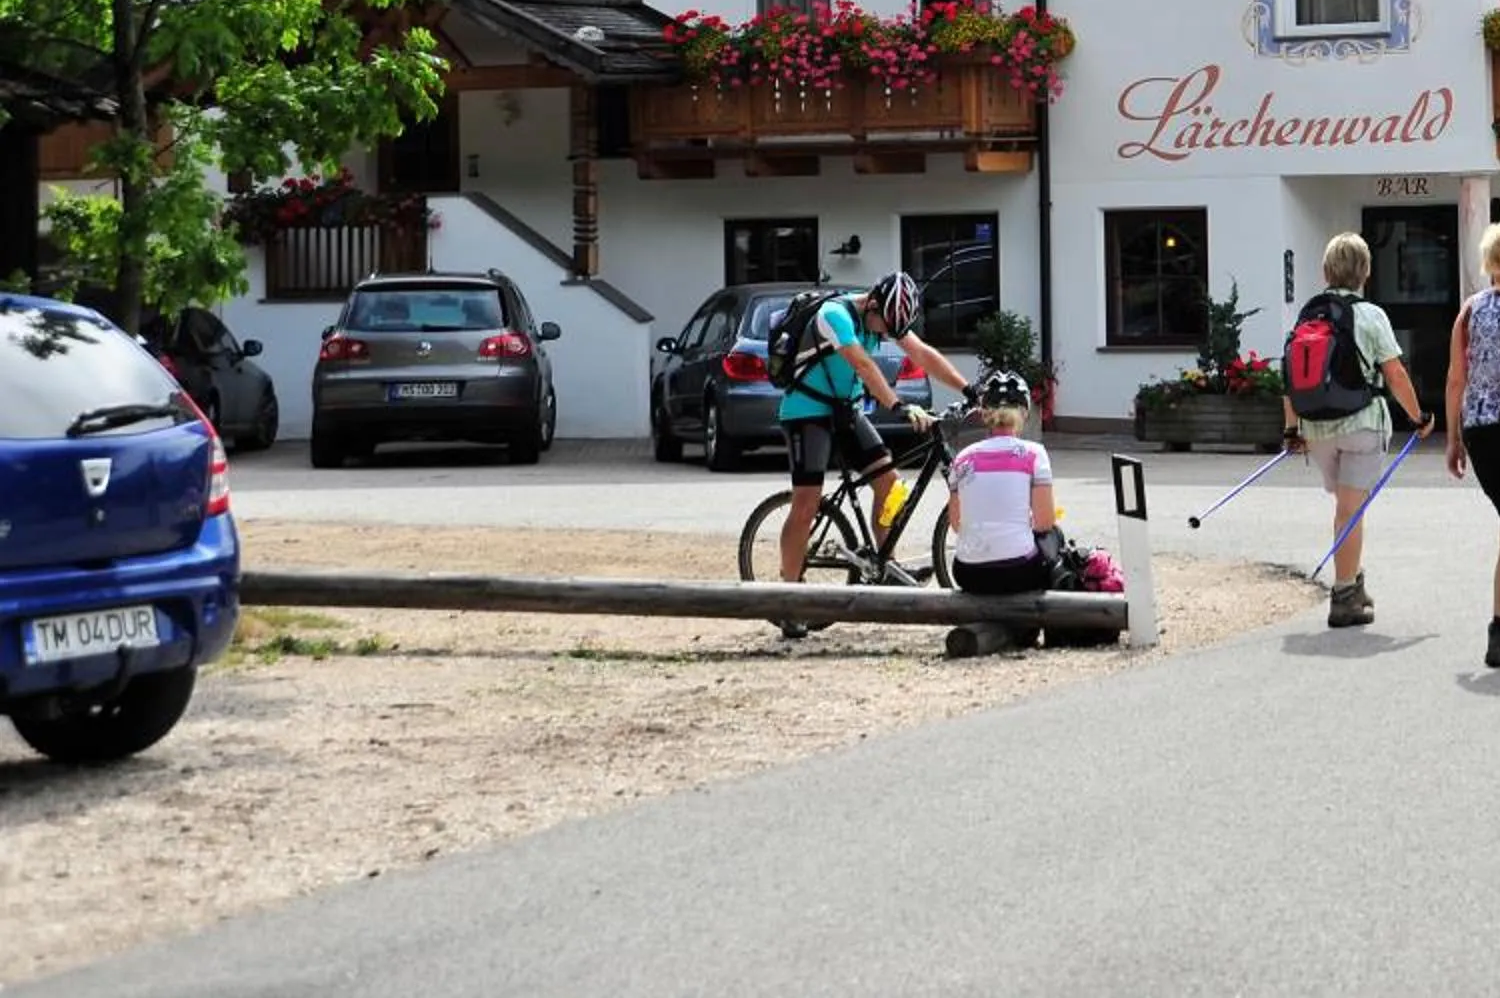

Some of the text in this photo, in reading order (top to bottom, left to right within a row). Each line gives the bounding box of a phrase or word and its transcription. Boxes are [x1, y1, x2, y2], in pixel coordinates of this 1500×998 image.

[1117, 64, 1454, 161] Lärchenwald
[1376, 176, 1431, 196] BAR
[38, 621, 70, 651] TM
